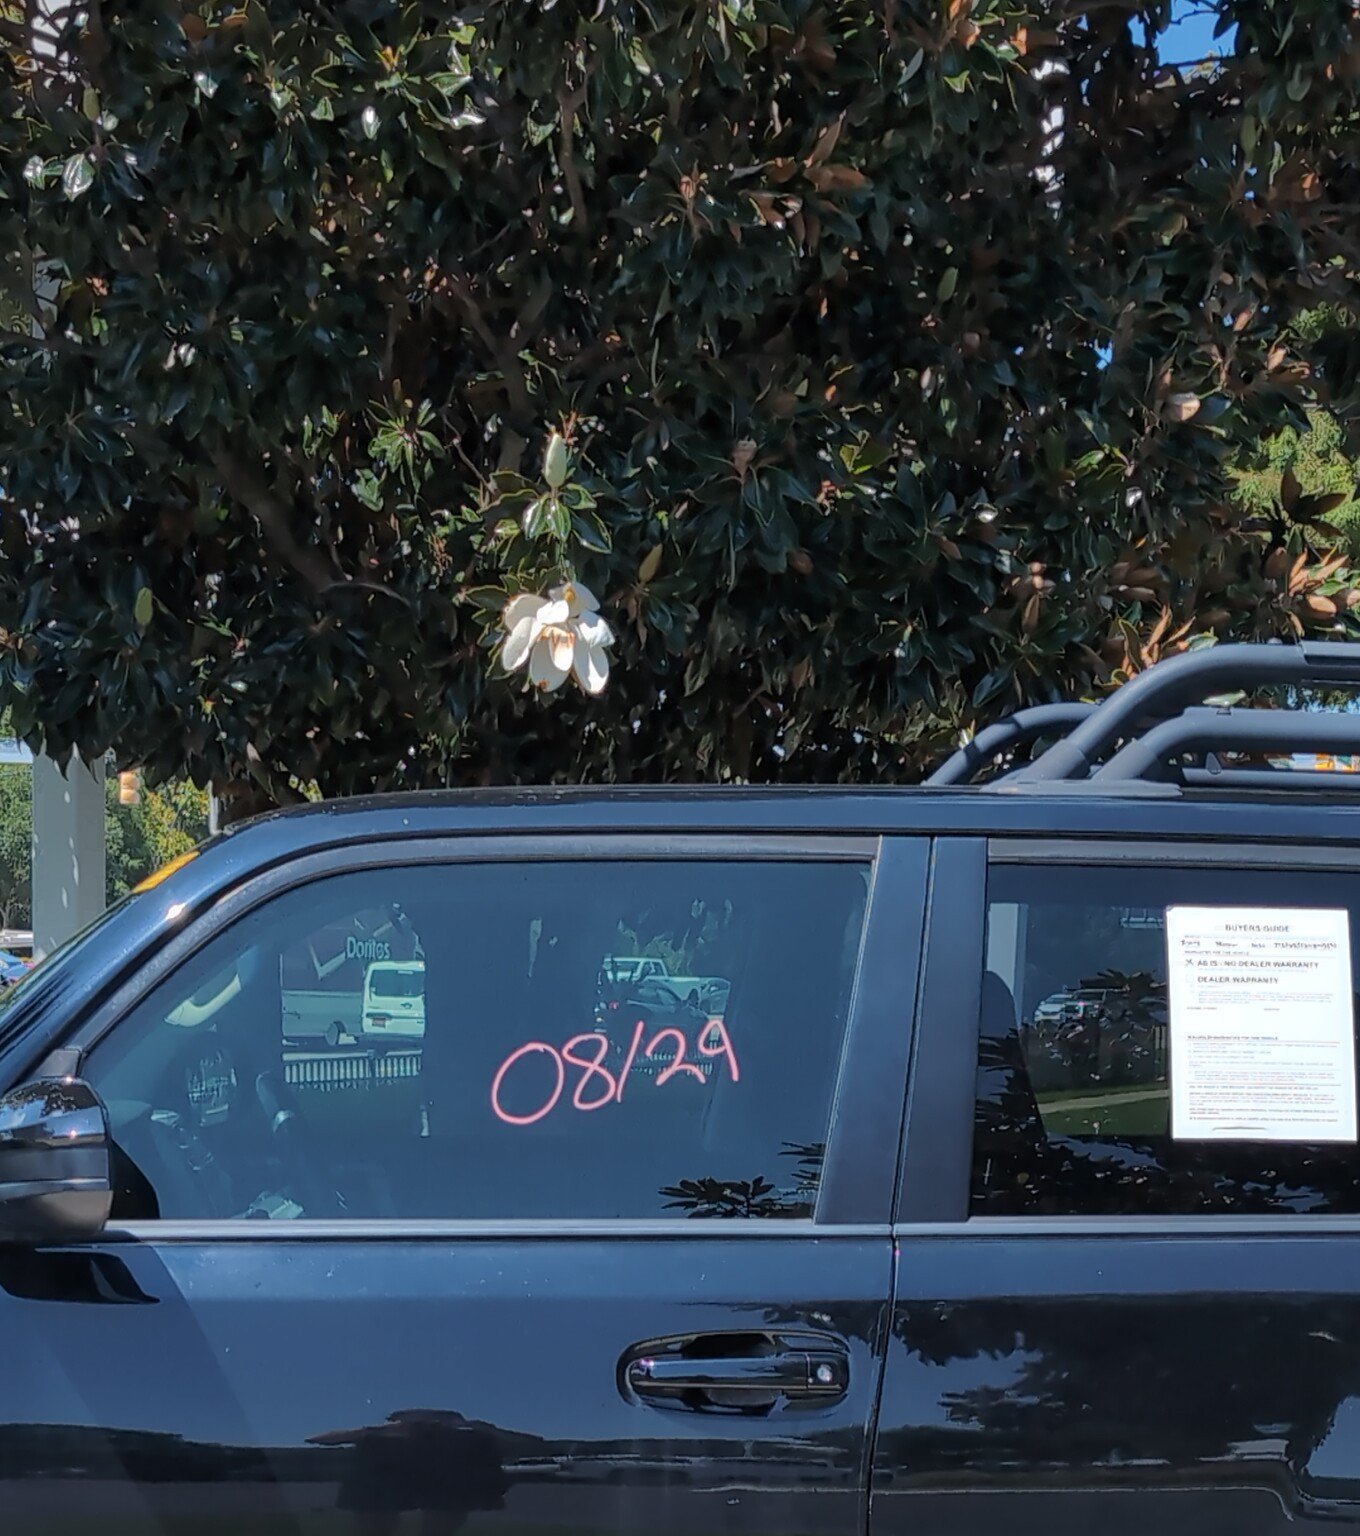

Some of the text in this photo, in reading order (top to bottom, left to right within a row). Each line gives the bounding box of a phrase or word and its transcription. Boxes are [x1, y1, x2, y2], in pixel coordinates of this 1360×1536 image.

[1225, 924, 1261, 932] BUYERS
[346, 936, 391, 959] Doritos
[491, 1018, 740, 1125] 08/29
